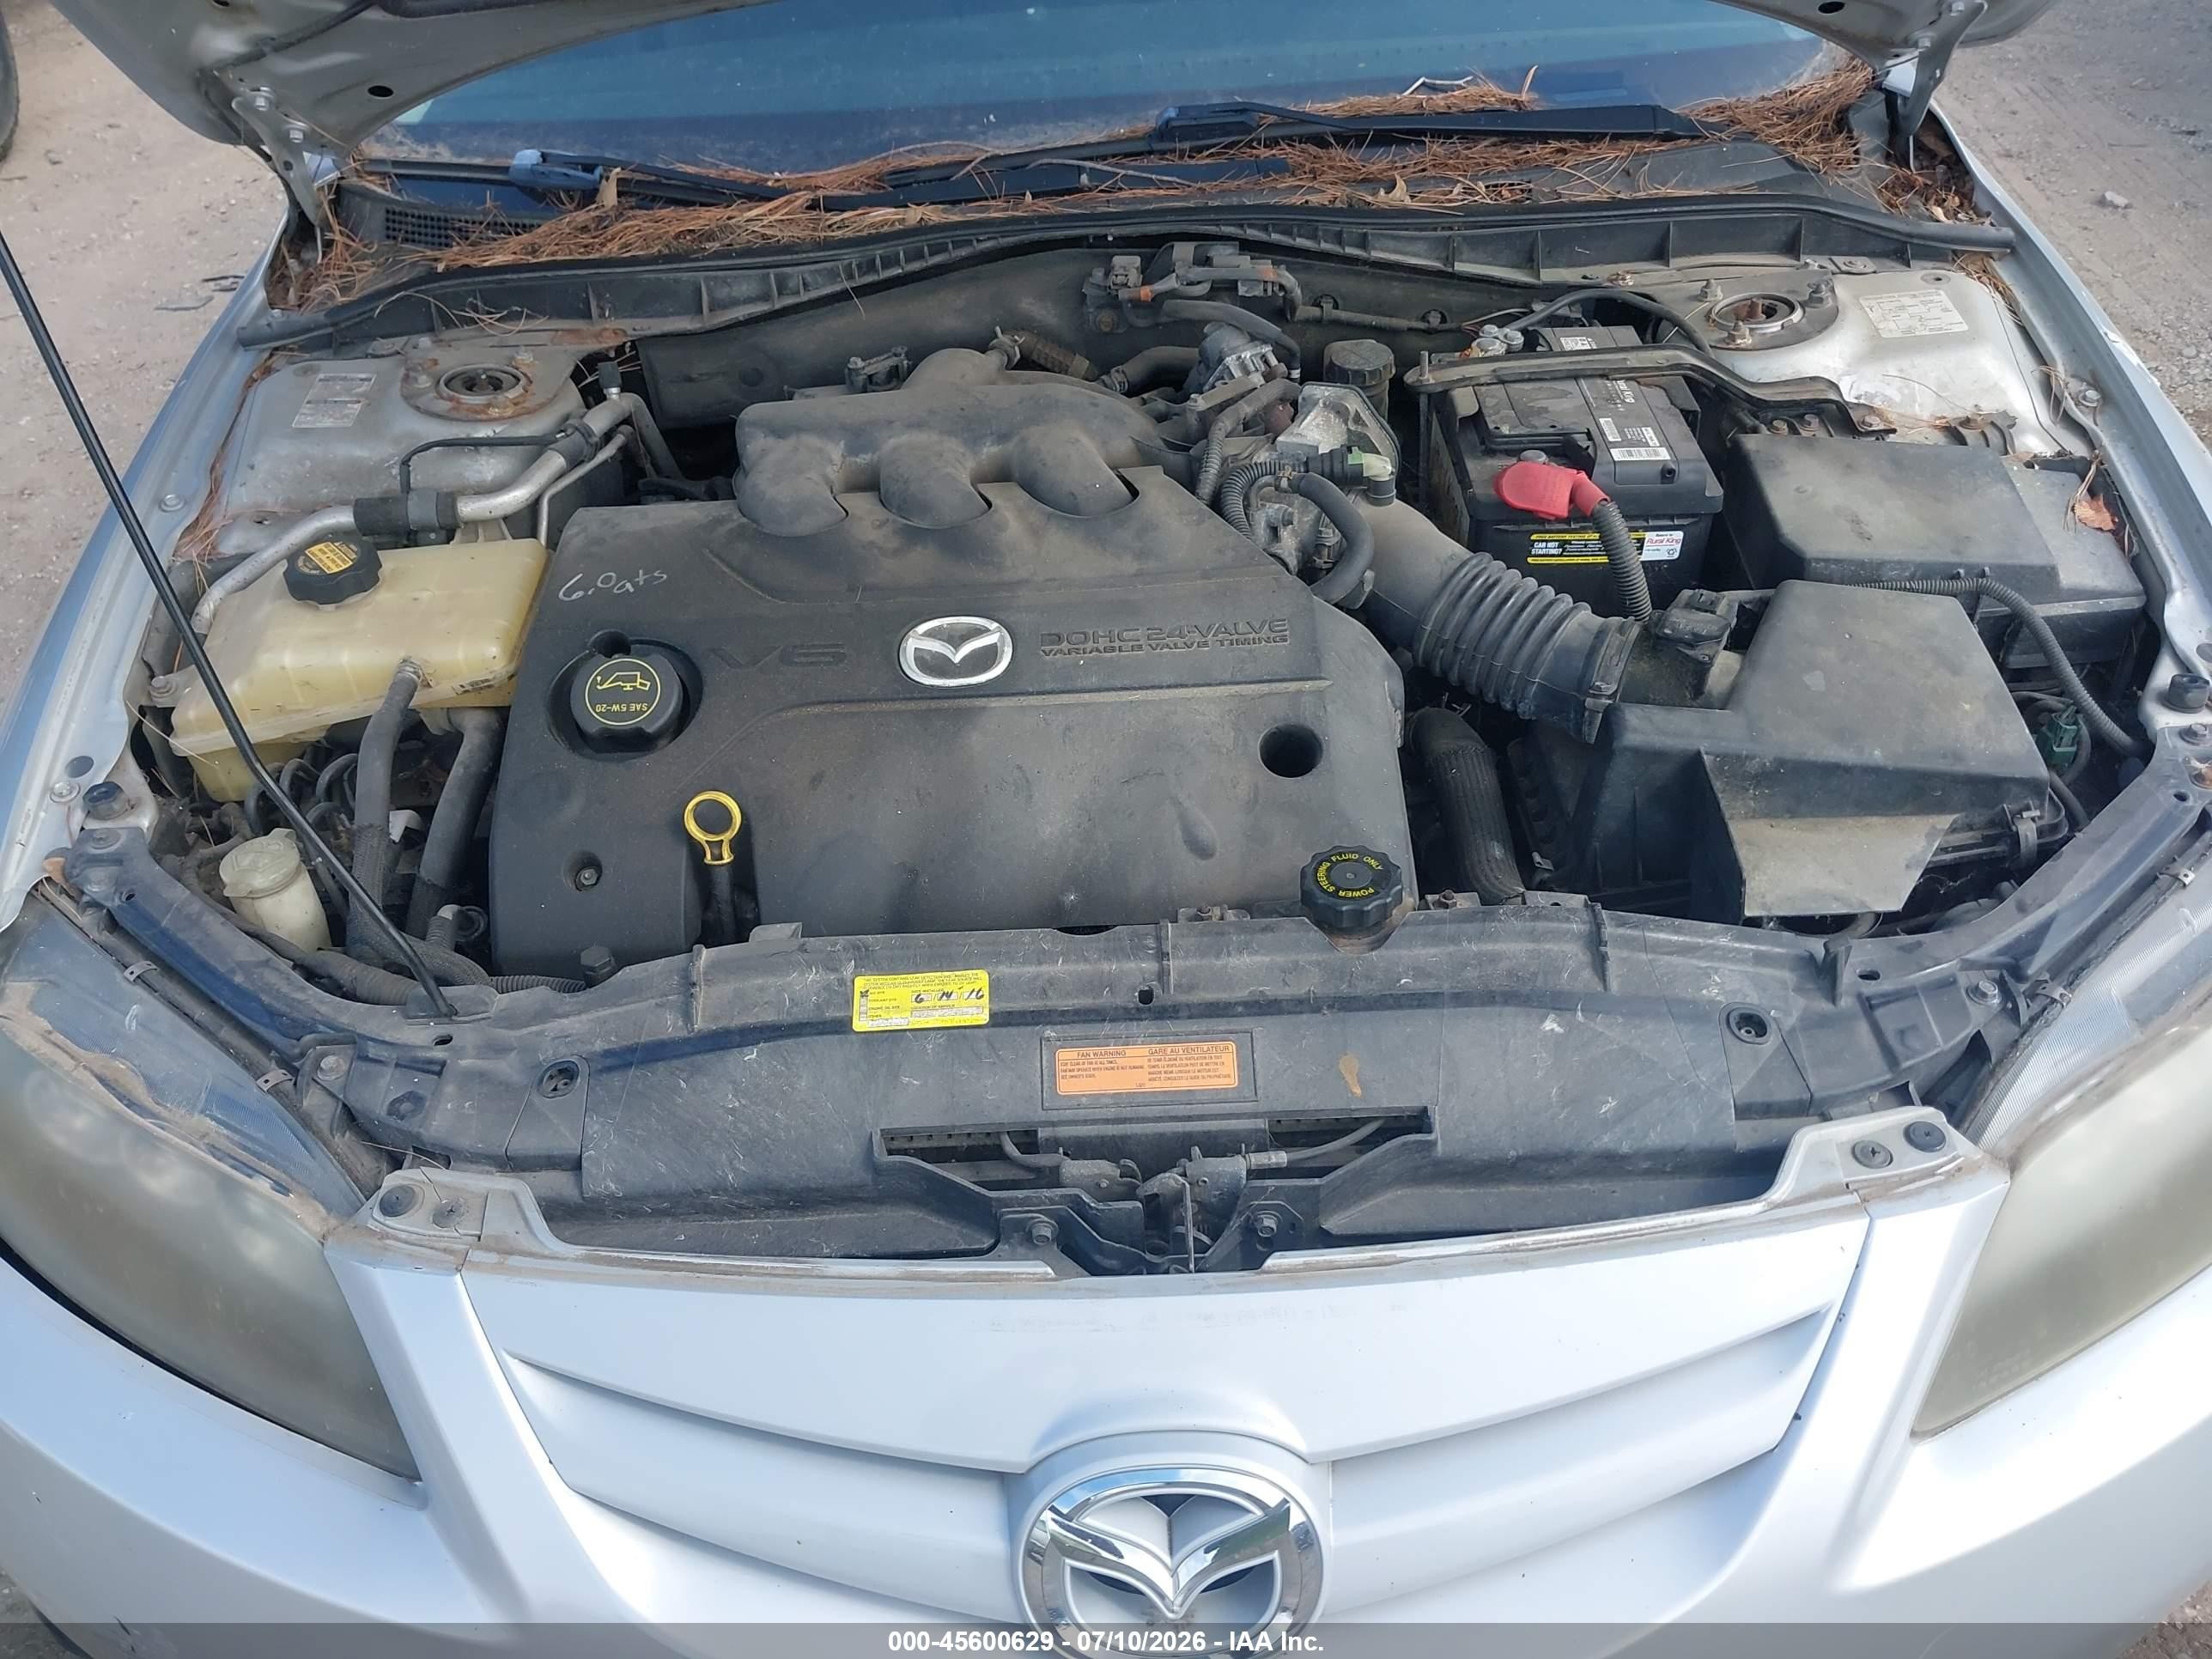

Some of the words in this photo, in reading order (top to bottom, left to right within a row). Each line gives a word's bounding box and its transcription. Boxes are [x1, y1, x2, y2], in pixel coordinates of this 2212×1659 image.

[1041, 628, 1141, 647] DOHC
[1041, 643, 1144, 657] VARIABLE
[1148, 640, 1210, 652] VALVE
[1216, 635, 1289, 647] TIMING
[706, 642, 848, 669] V6
[596, 704, 627, 713] 5W-20
[630, 702, 647, 711] SAE
[1331, 853, 1359, 862] FLUID
[1363, 855, 1384, 870] ONLY
[1317, 861, 1335, 892] STEERING
[1338, 886, 1374, 897] POWER
[1092, 1049, 1127, 1058] WARNING
